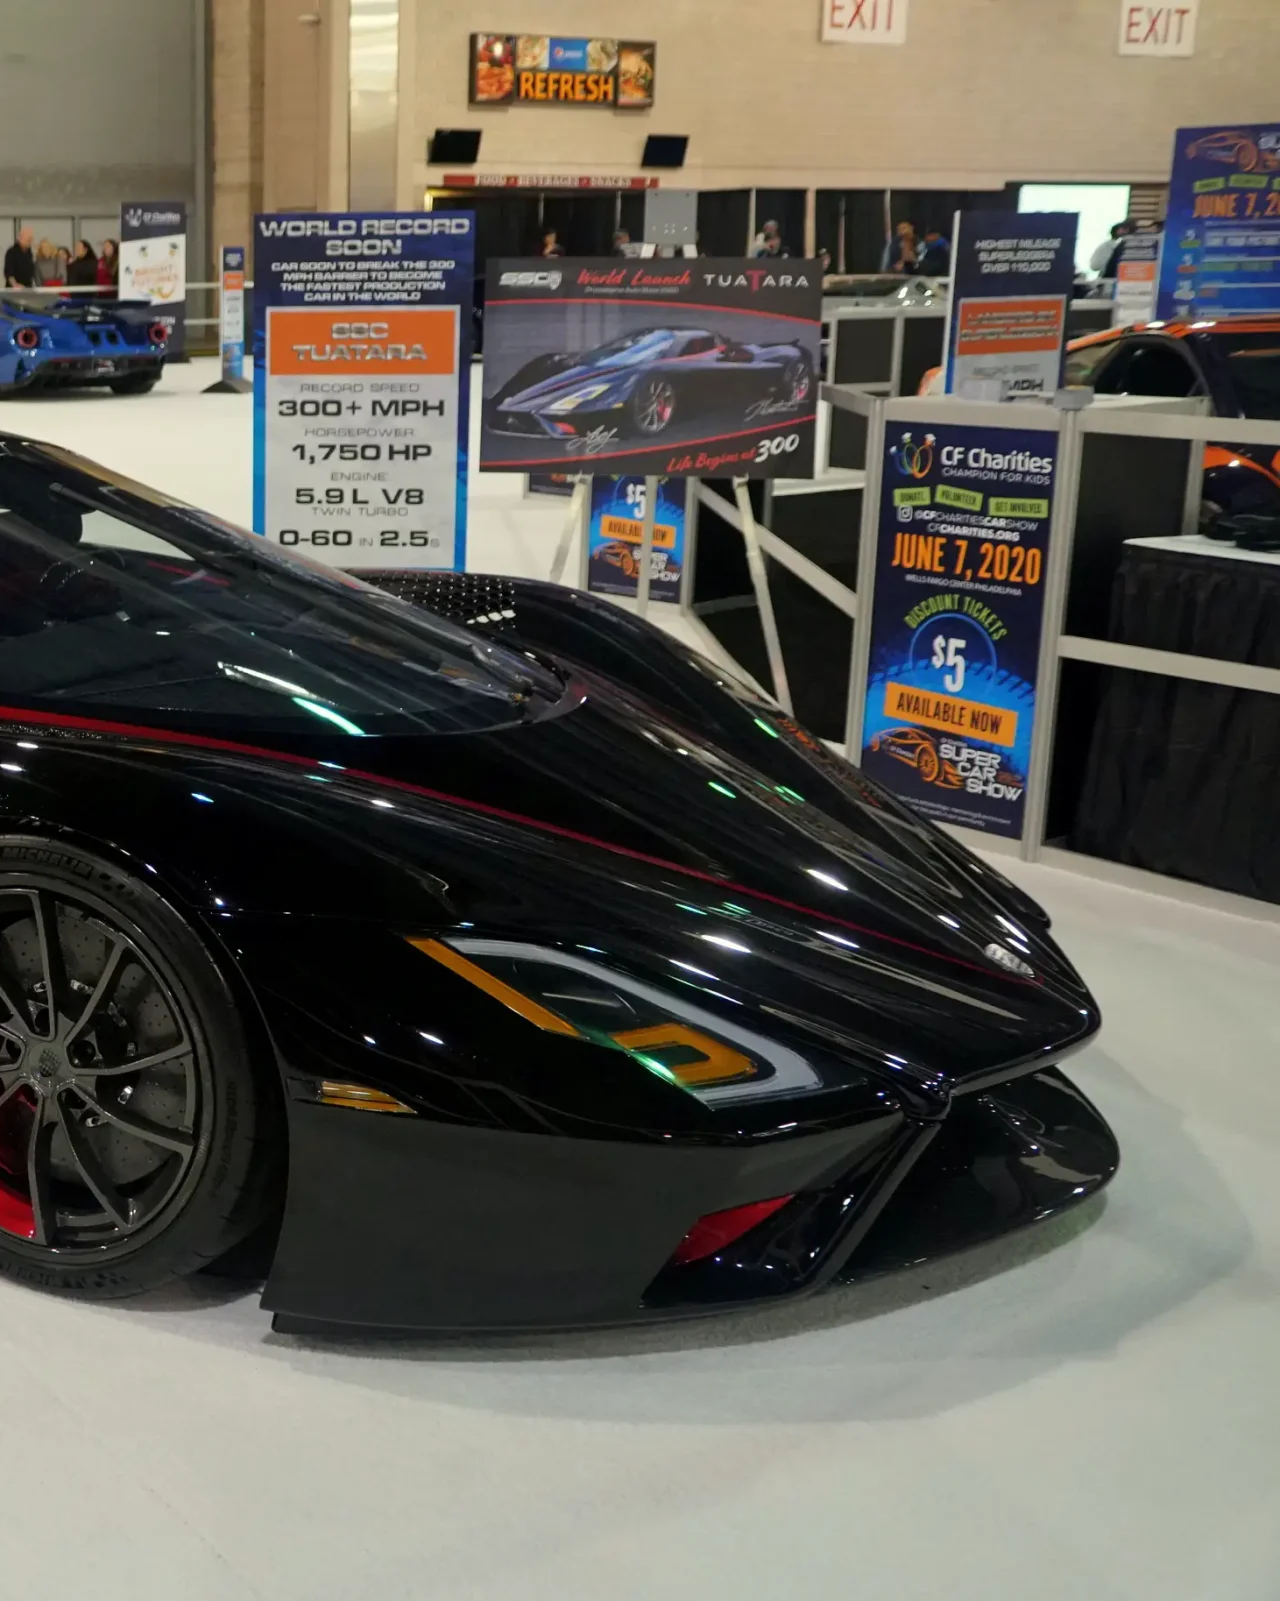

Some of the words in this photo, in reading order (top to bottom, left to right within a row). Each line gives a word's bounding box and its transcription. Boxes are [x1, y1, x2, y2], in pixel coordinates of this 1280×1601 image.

[1125, 7, 1190, 45] EXIT
[520, 71, 614, 101] REFRESH
[260, 220, 356, 237] WORLD
[361, 218, 470, 236] RECORD
[326, 239, 402, 256] SOON
[271, 262, 298, 272] CAR
[338, 261, 355, 271] TO
[357, 261, 400, 271] BREAK
[402, 260, 426, 270] THE
[981, 262, 1010, 274] OVER
[283, 272, 313, 282] MPH
[314, 271, 369, 281] BARRIER
[370, 271, 388, 281] TO
[388, 270, 443, 281] BECOME
[499, 271, 551, 286] SSC
[577, 268, 627, 285] World
[631, 267, 691, 286] Launch
[703, 270, 809, 292] TUATARA
[280, 282, 305, 292] THE
[306, 282, 362, 291] FASTEST
[363, 281, 446, 291] PRODUCTION
[304, 292, 331, 302] CAR
[332, 292, 346, 301] IN
[347, 292, 372, 301] THE
[374, 291, 421, 301] WORLD
[331, 322, 389, 340] SSC
[292, 344, 428, 361] TUATARA
[300, 383, 364, 393] RECORD
[370, 383, 420, 393] SPEED
[278, 400, 362, 417] 300+
[371, 400, 445, 417] MPH
[305, 428, 415, 437] HORSEPOWER
[292, 444, 381, 464] 1,750
[388, 444, 432, 461] HP
[754, 434, 800, 463] 300
[941, 446, 965, 466] CF
[968, 447, 1053, 473] Charities
[331, 472, 387, 482] ENGINE
[941, 467, 997, 481] CHAMPION
[1000, 471, 1023, 483] FOR
[1025, 474, 1051, 486] KIDS
[295, 488, 345, 505] 5.9
[352, 489, 370, 504] L
[382, 488, 425, 505] V8
[312, 507, 351, 516] TWIN
[358, 507, 409, 516] TURBO
[279, 530, 353, 547] 0-60
[359, 538, 374, 547] IN
[927, 522, 1020, 542] CFCHARITIES.ORG
[891, 533, 947, 572] JUNE
[953, 539, 973, 581] 7,
[977, 542, 1042, 585] 2020
[905, 573, 926, 583] WELLS
[927, 575, 948, 586] FARGO
[904, 594, 961, 629] DISCOUNT
[962, 595, 1008, 641] TICKETS
[931, 635, 967, 693] $5
[896, 692, 967, 727] AVAILABLE
[970, 709, 1004, 735] NOW
[940, 744, 1002, 769] SUPER
[957, 761, 997, 782] CAR
[966, 778, 1023, 801] SHOW
